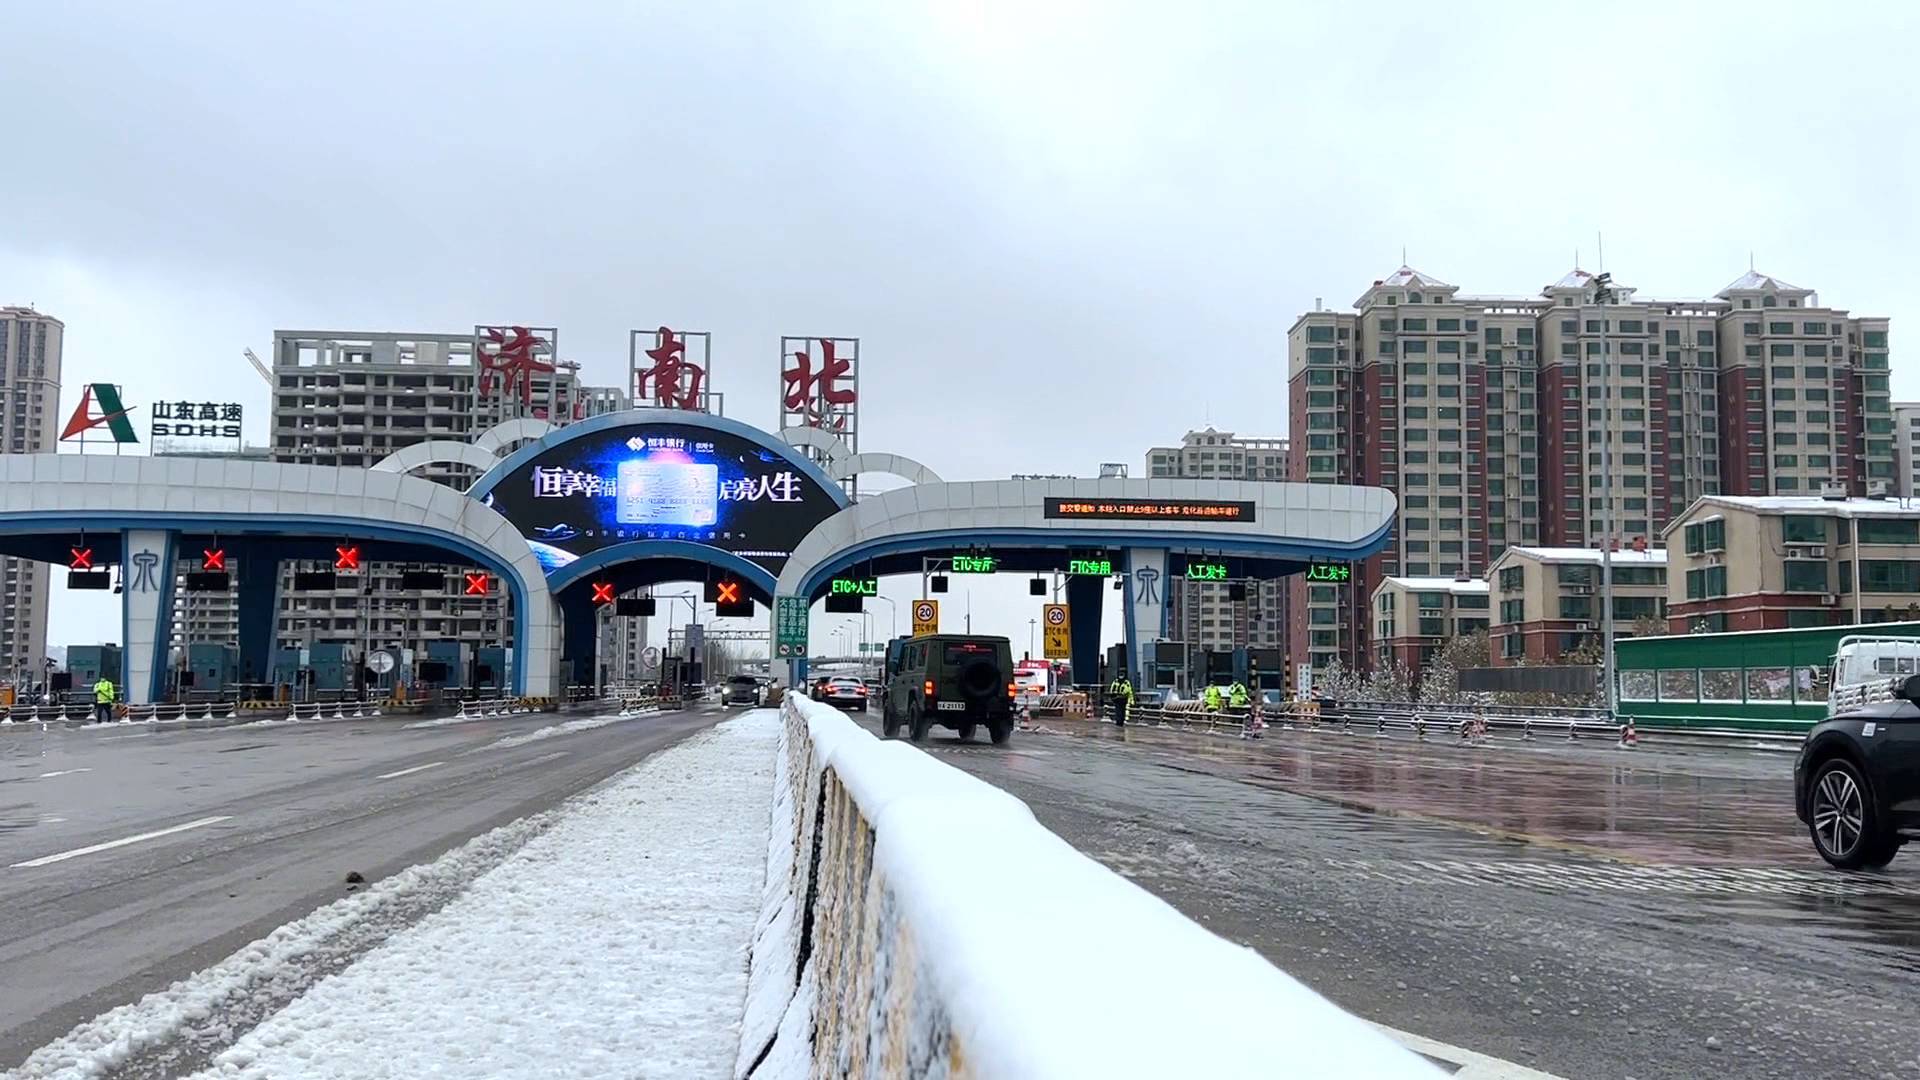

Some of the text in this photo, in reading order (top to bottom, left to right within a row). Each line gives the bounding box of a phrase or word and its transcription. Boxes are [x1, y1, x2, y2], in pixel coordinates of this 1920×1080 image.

[152, 400, 242, 422] 山东高速
[151, 423, 242, 438] SDHS
[530, 465, 804, 502] 恒享幸福 启亮人生
[1186, 563, 1227, 580] 人工发卡
[1307, 564, 1349, 580] 人工发卡
[831, 579, 876, 595] ETC+人工
[919, 607, 932, 618] 20
[1050, 611, 1063, 621] 20
